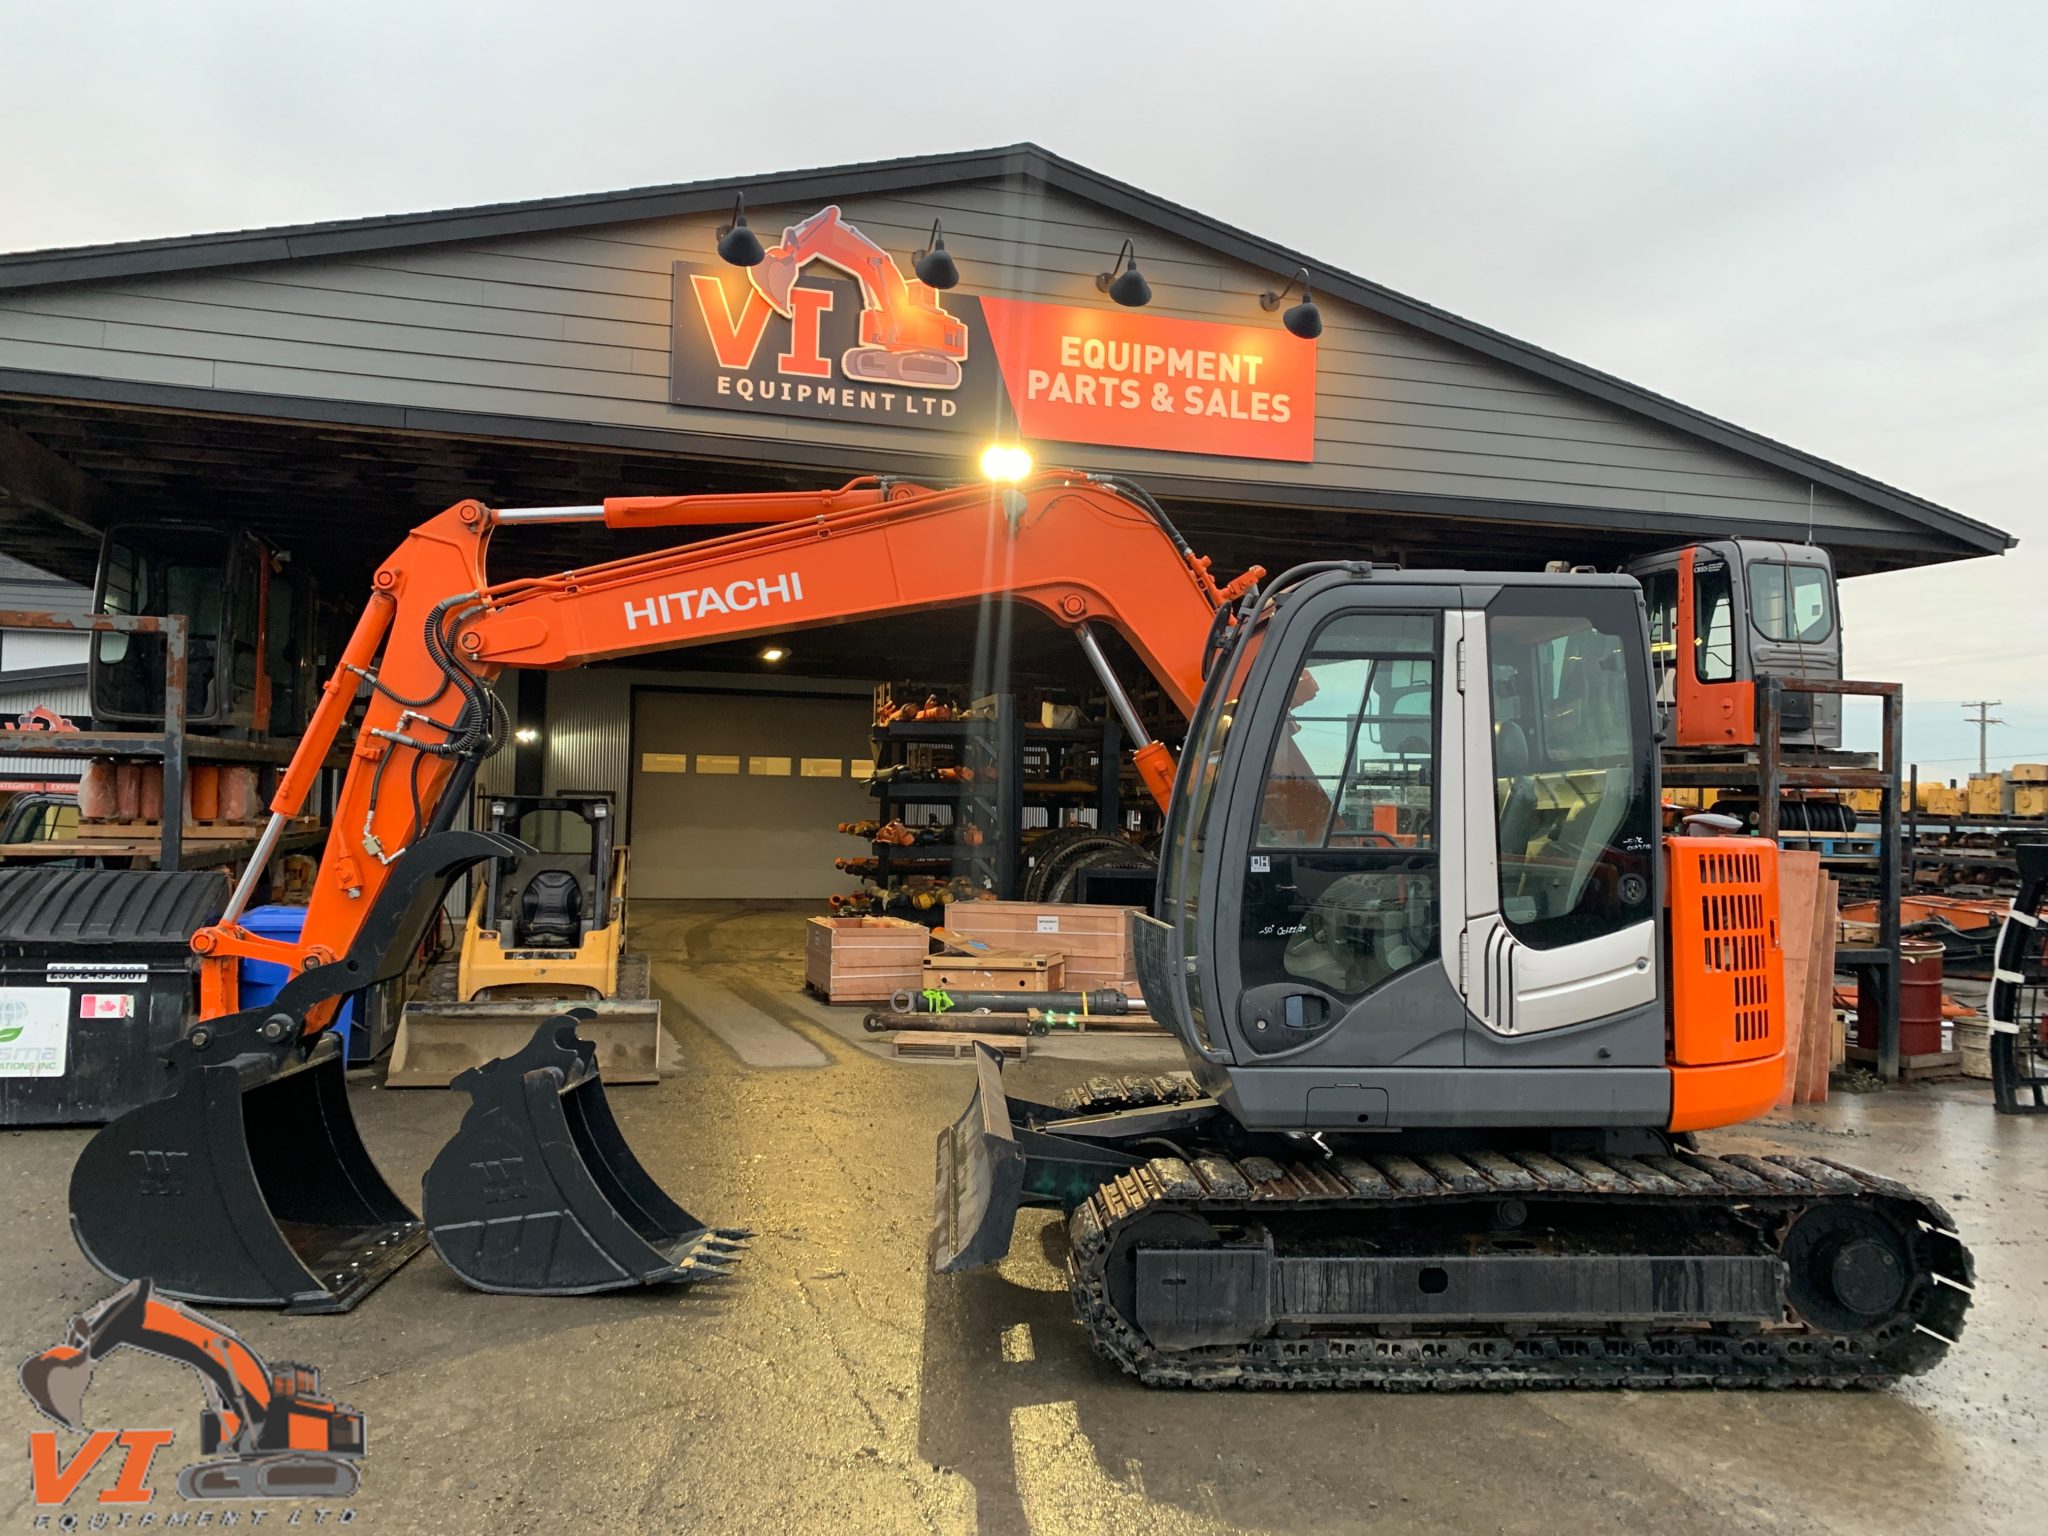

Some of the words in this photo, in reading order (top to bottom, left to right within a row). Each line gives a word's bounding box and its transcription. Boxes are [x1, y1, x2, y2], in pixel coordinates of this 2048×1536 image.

[689, 274, 834, 379] VI
[1060, 335, 1264, 385] EQUIPMENT
[716, 375, 896, 412] EQUIPMENT
[905, 394, 958, 418] LTD
[1027, 368, 1141, 410] PARTS
[1150, 381, 1176, 414] &
[1183, 384, 1292, 424] SALES
[623, 571, 804, 631] HITACHI
